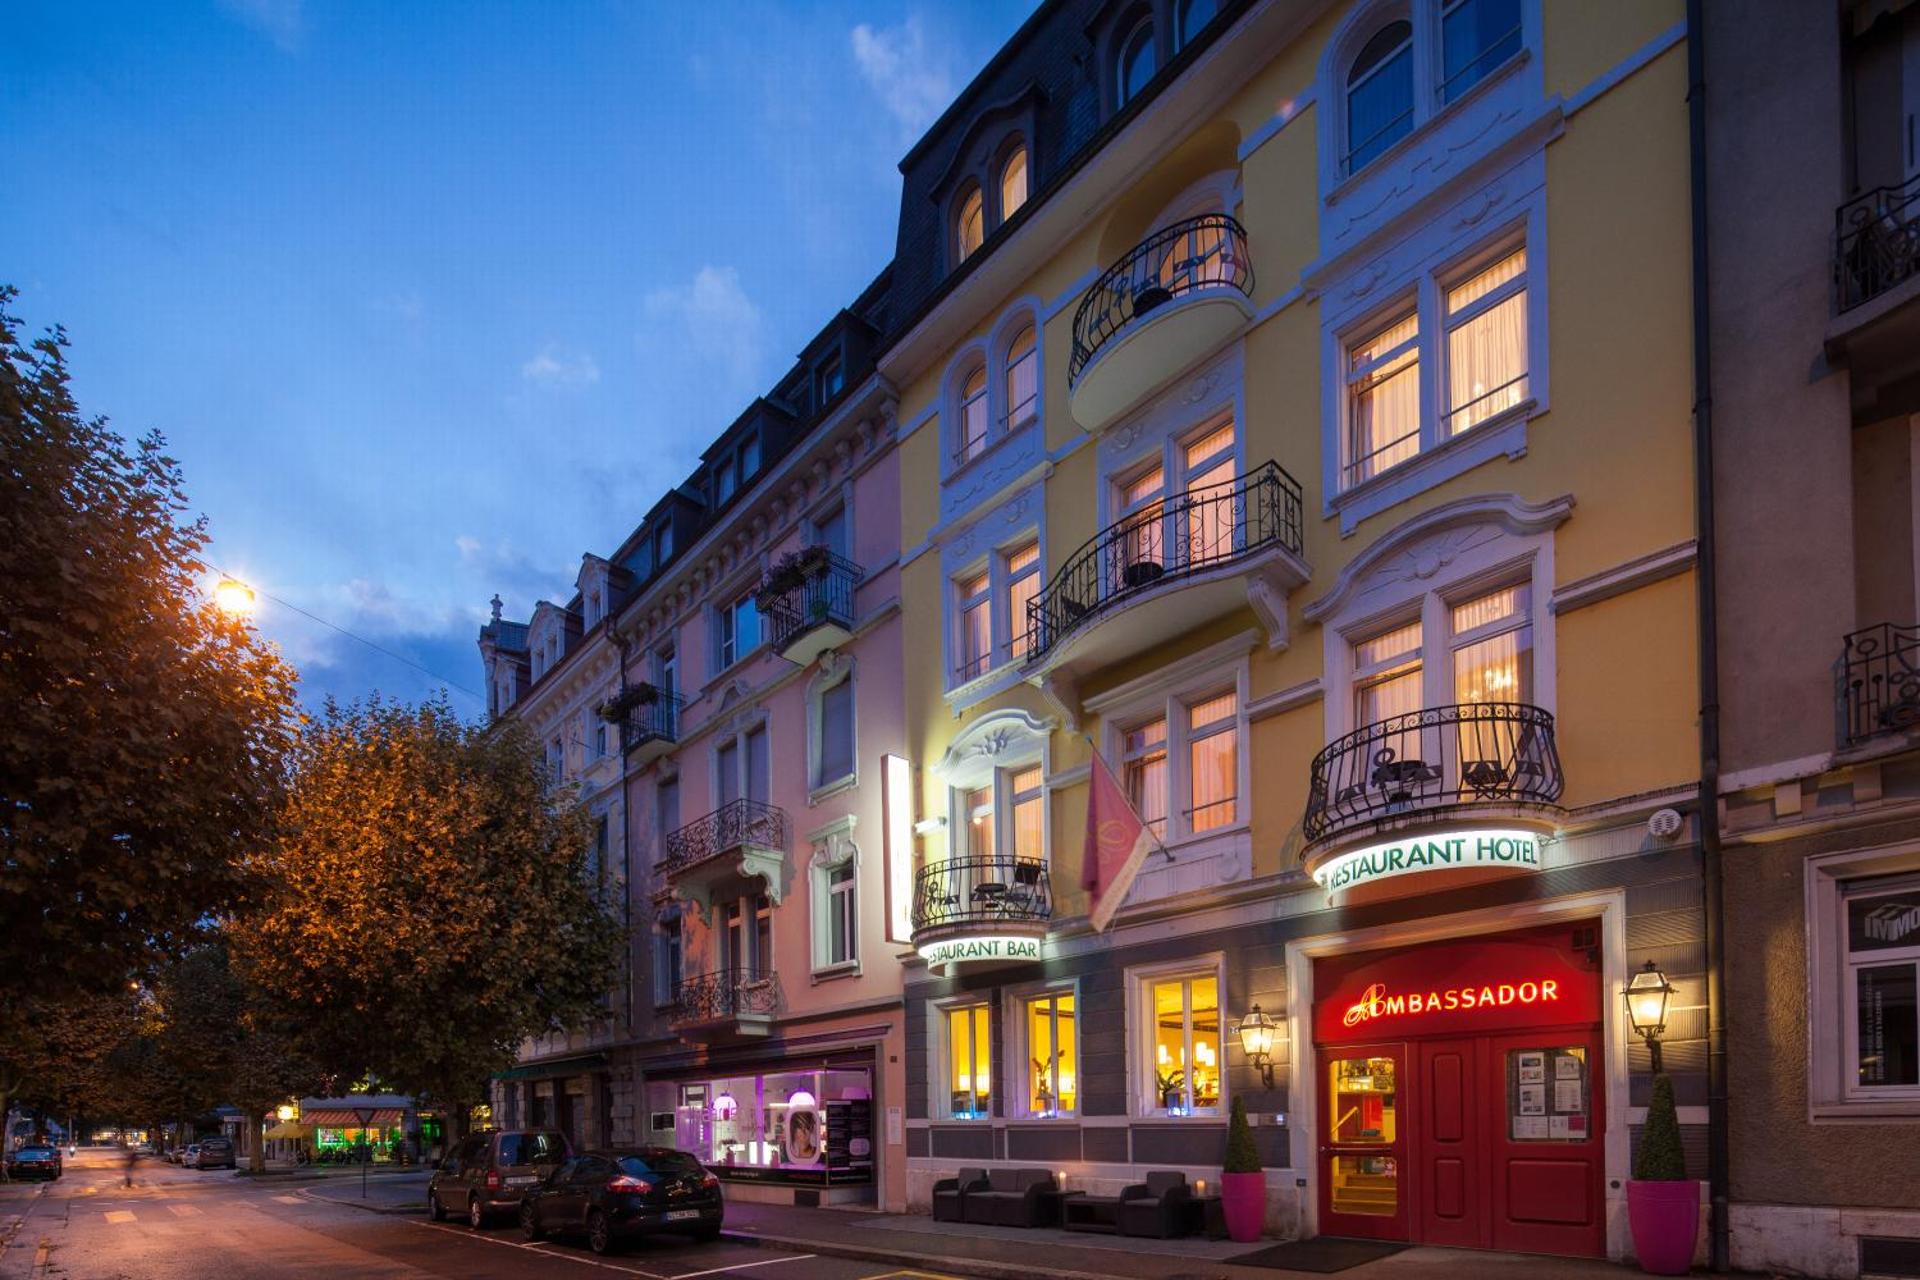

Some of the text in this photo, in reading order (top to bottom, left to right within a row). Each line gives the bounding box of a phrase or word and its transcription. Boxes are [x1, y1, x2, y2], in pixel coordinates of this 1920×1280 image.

[1330, 837, 1538, 891] RESTAURANT HOTEL
[1007, 941, 1037, 957] BAR
